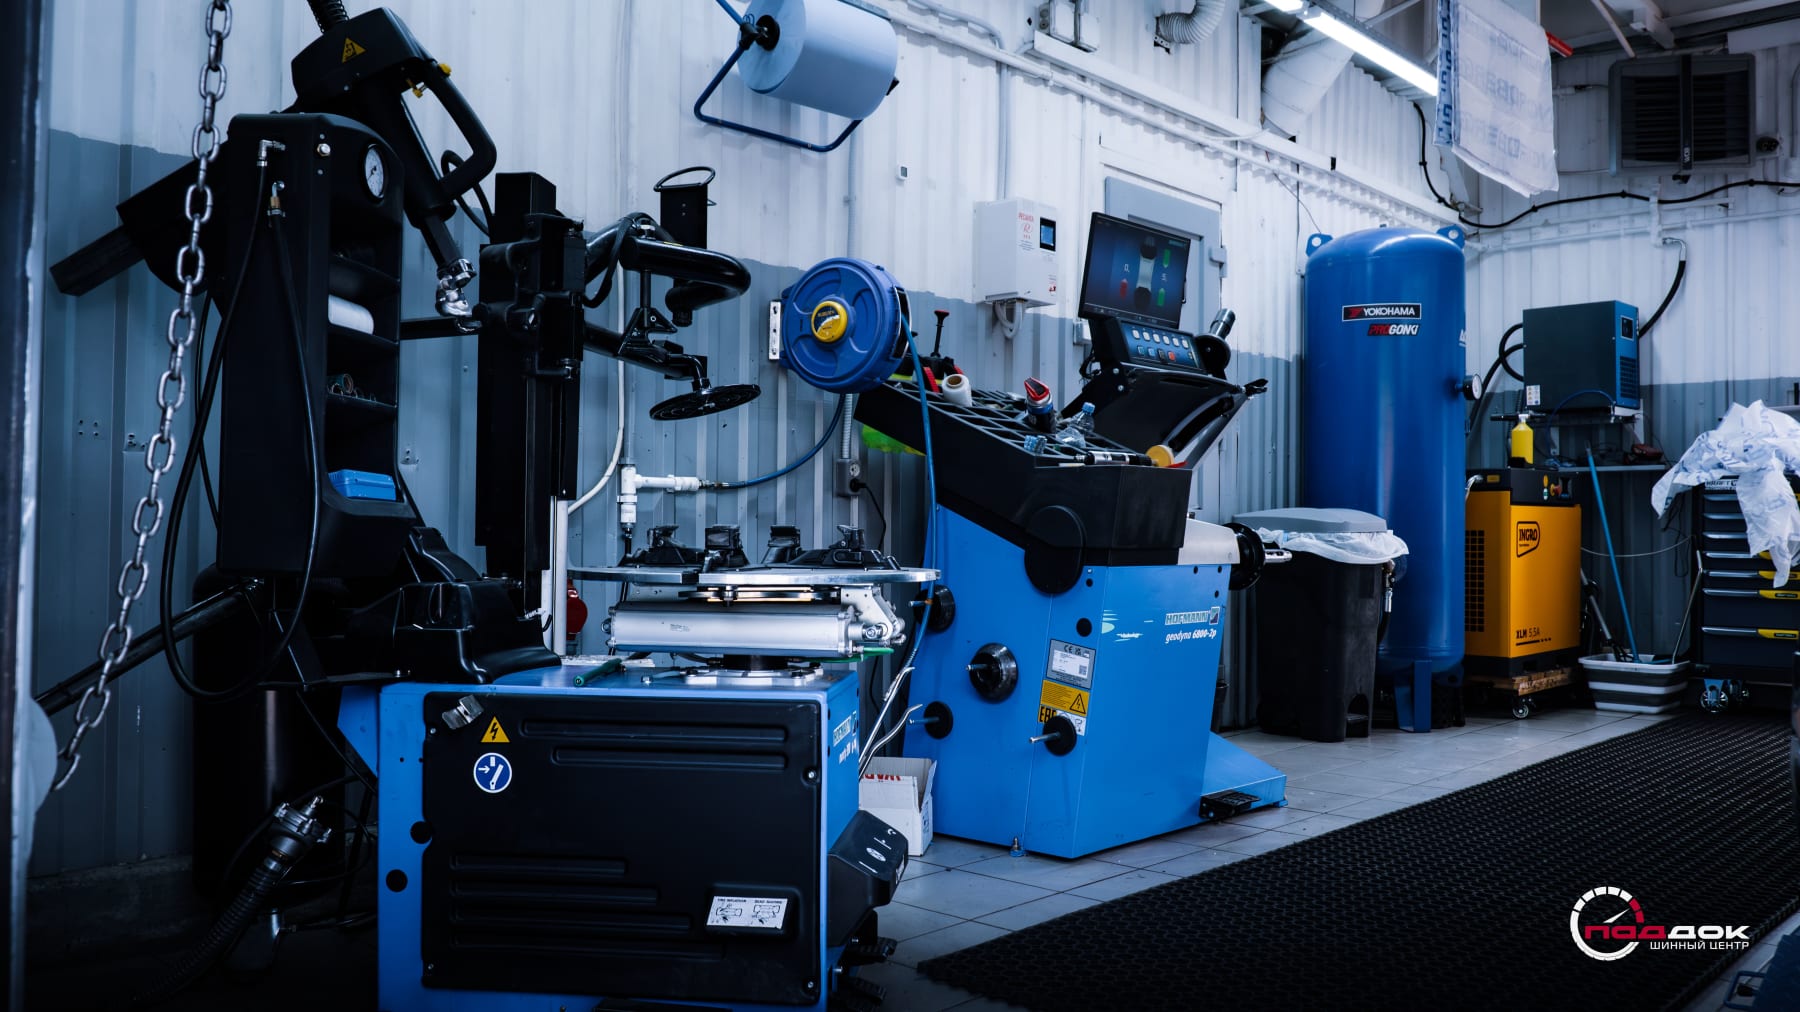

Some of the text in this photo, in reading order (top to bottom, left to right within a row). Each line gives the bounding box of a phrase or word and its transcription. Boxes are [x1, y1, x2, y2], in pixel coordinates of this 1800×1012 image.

[1363, 306, 1415, 316] YOKOHAMA
[1518, 528, 1538, 541] INGRO
[1165, 611, 1209, 625] HOFMANN
[1165, 630, 1192, 643] geodyna
[1516, 629, 1528, 640] XLM
